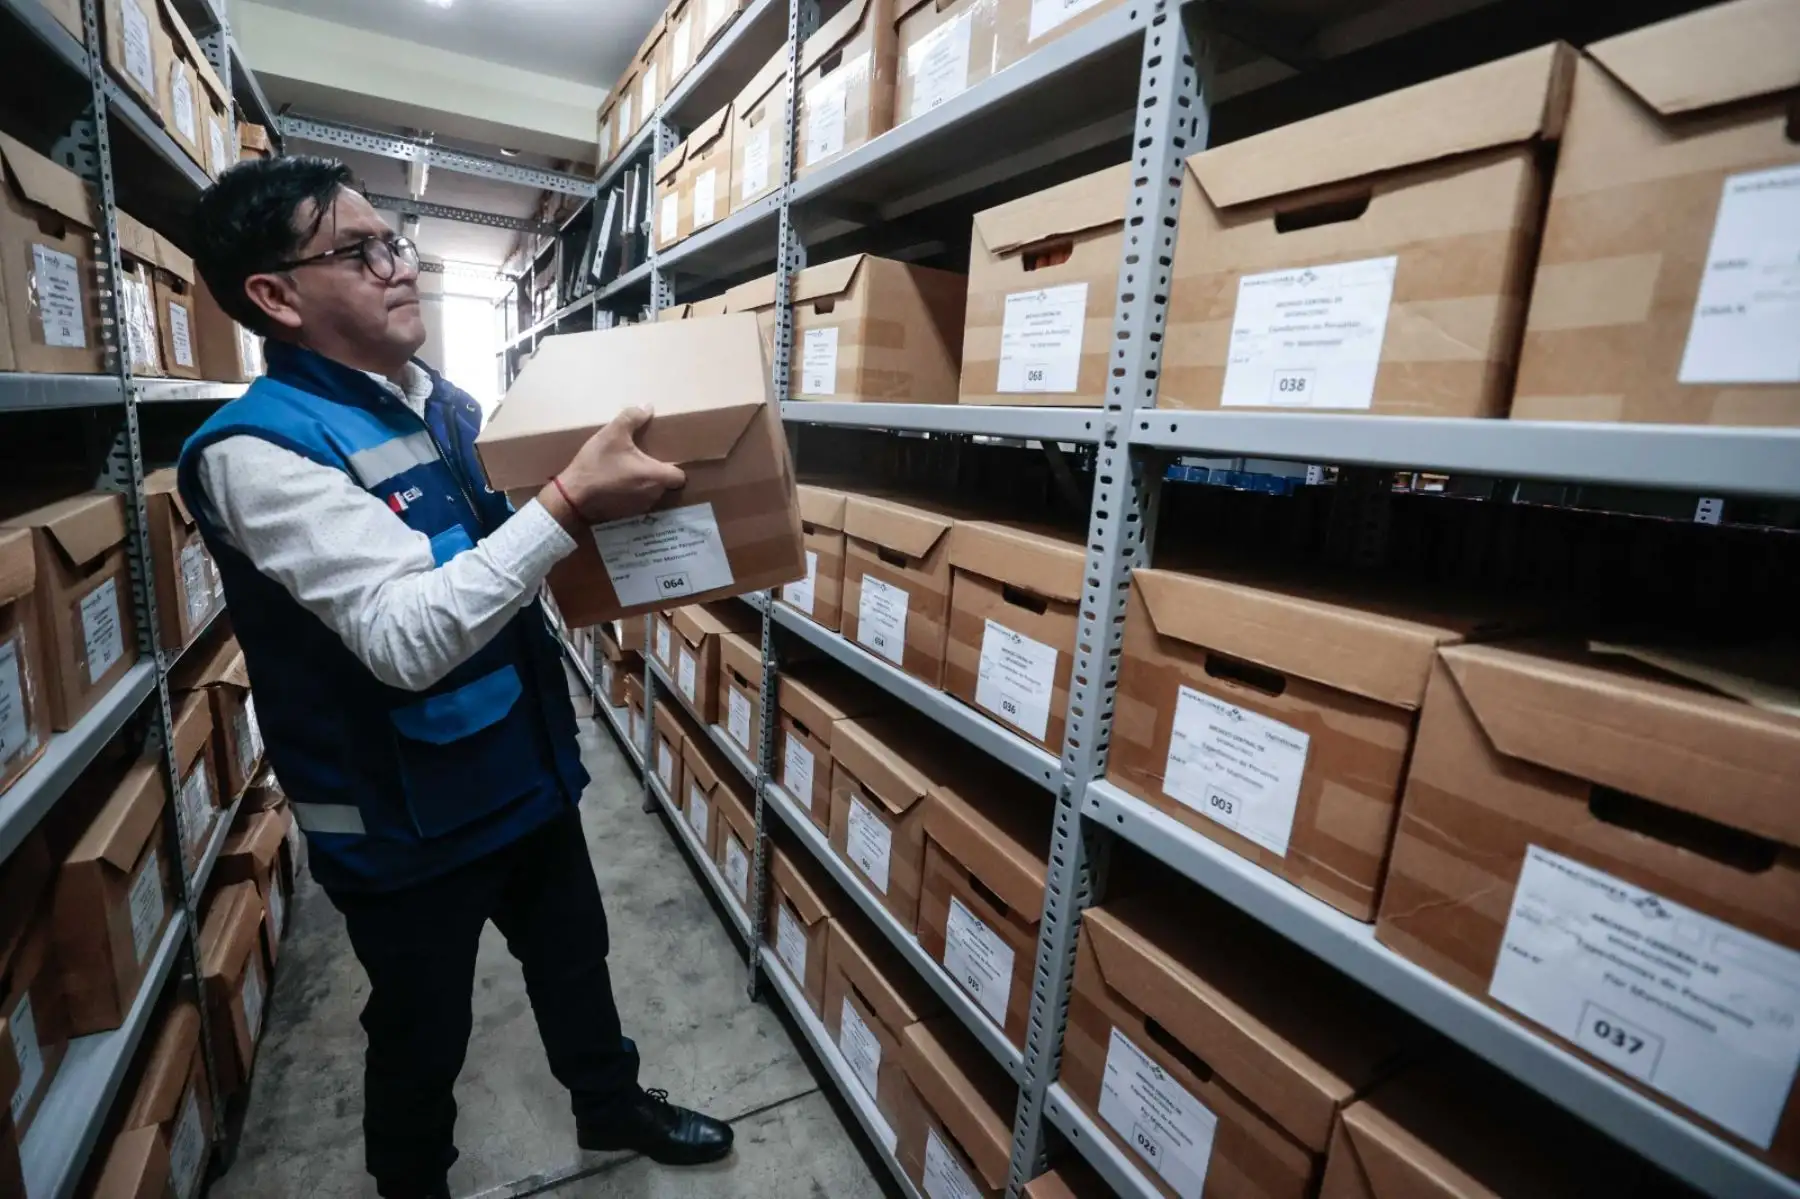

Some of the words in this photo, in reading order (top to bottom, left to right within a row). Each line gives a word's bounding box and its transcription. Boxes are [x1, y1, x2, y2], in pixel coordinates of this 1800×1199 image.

[1279, 377, 1306, 392] 038
[663, 578, 684, 589] 064
[1002, 700, 1016, 714] 036
[1211, 795, 1233, 814] 003
[1593, 1020, 1645, 1055] 037
[1137, 1134, 1156, 1157] 026
